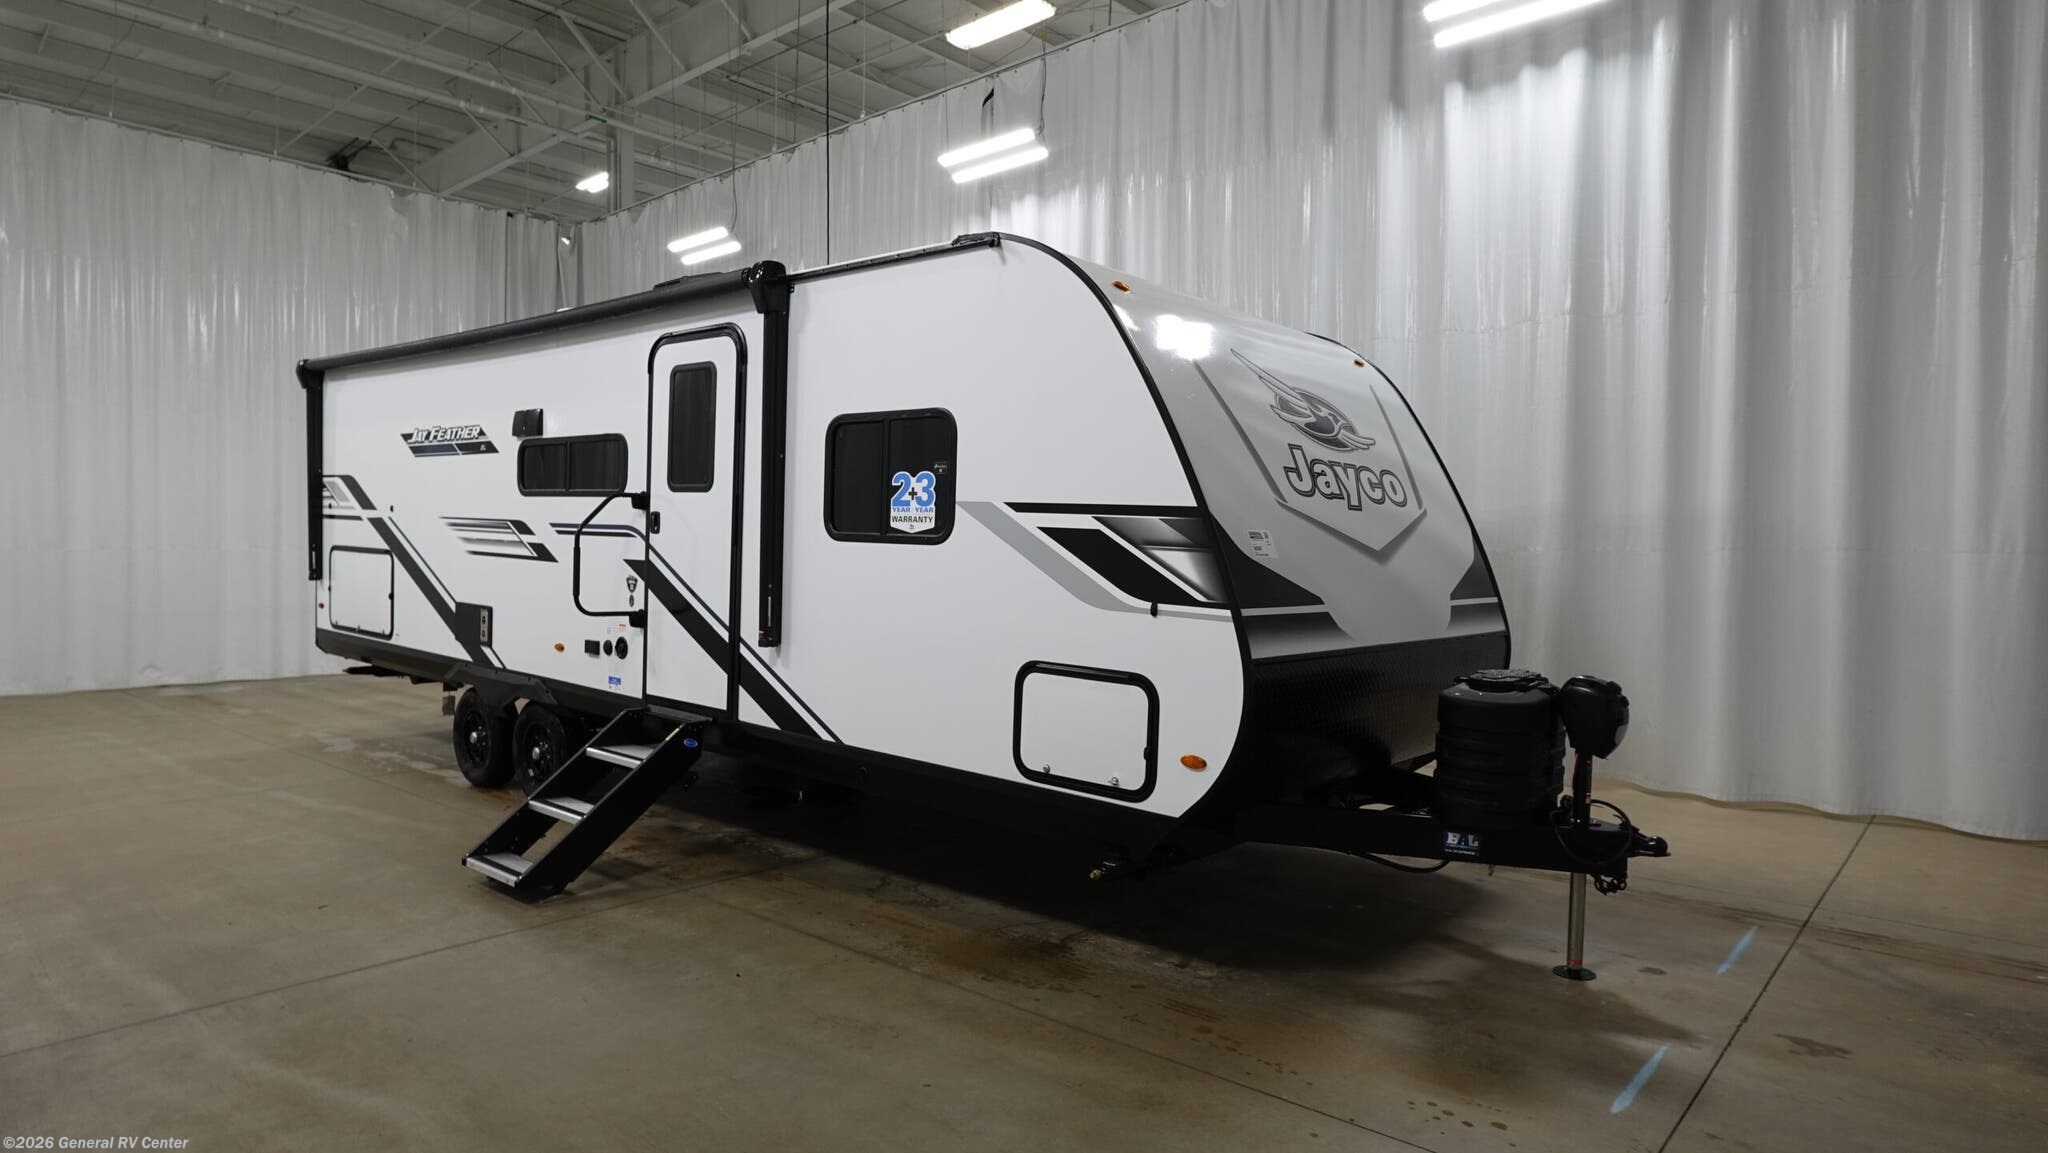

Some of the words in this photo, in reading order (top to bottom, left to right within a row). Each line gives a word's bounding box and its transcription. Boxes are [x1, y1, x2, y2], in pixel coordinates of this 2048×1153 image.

[407, 428, 429, 443] JAY
[430, 425, 481, 442] FEATHER
[1283, 443, 1407, 511] Jayco
